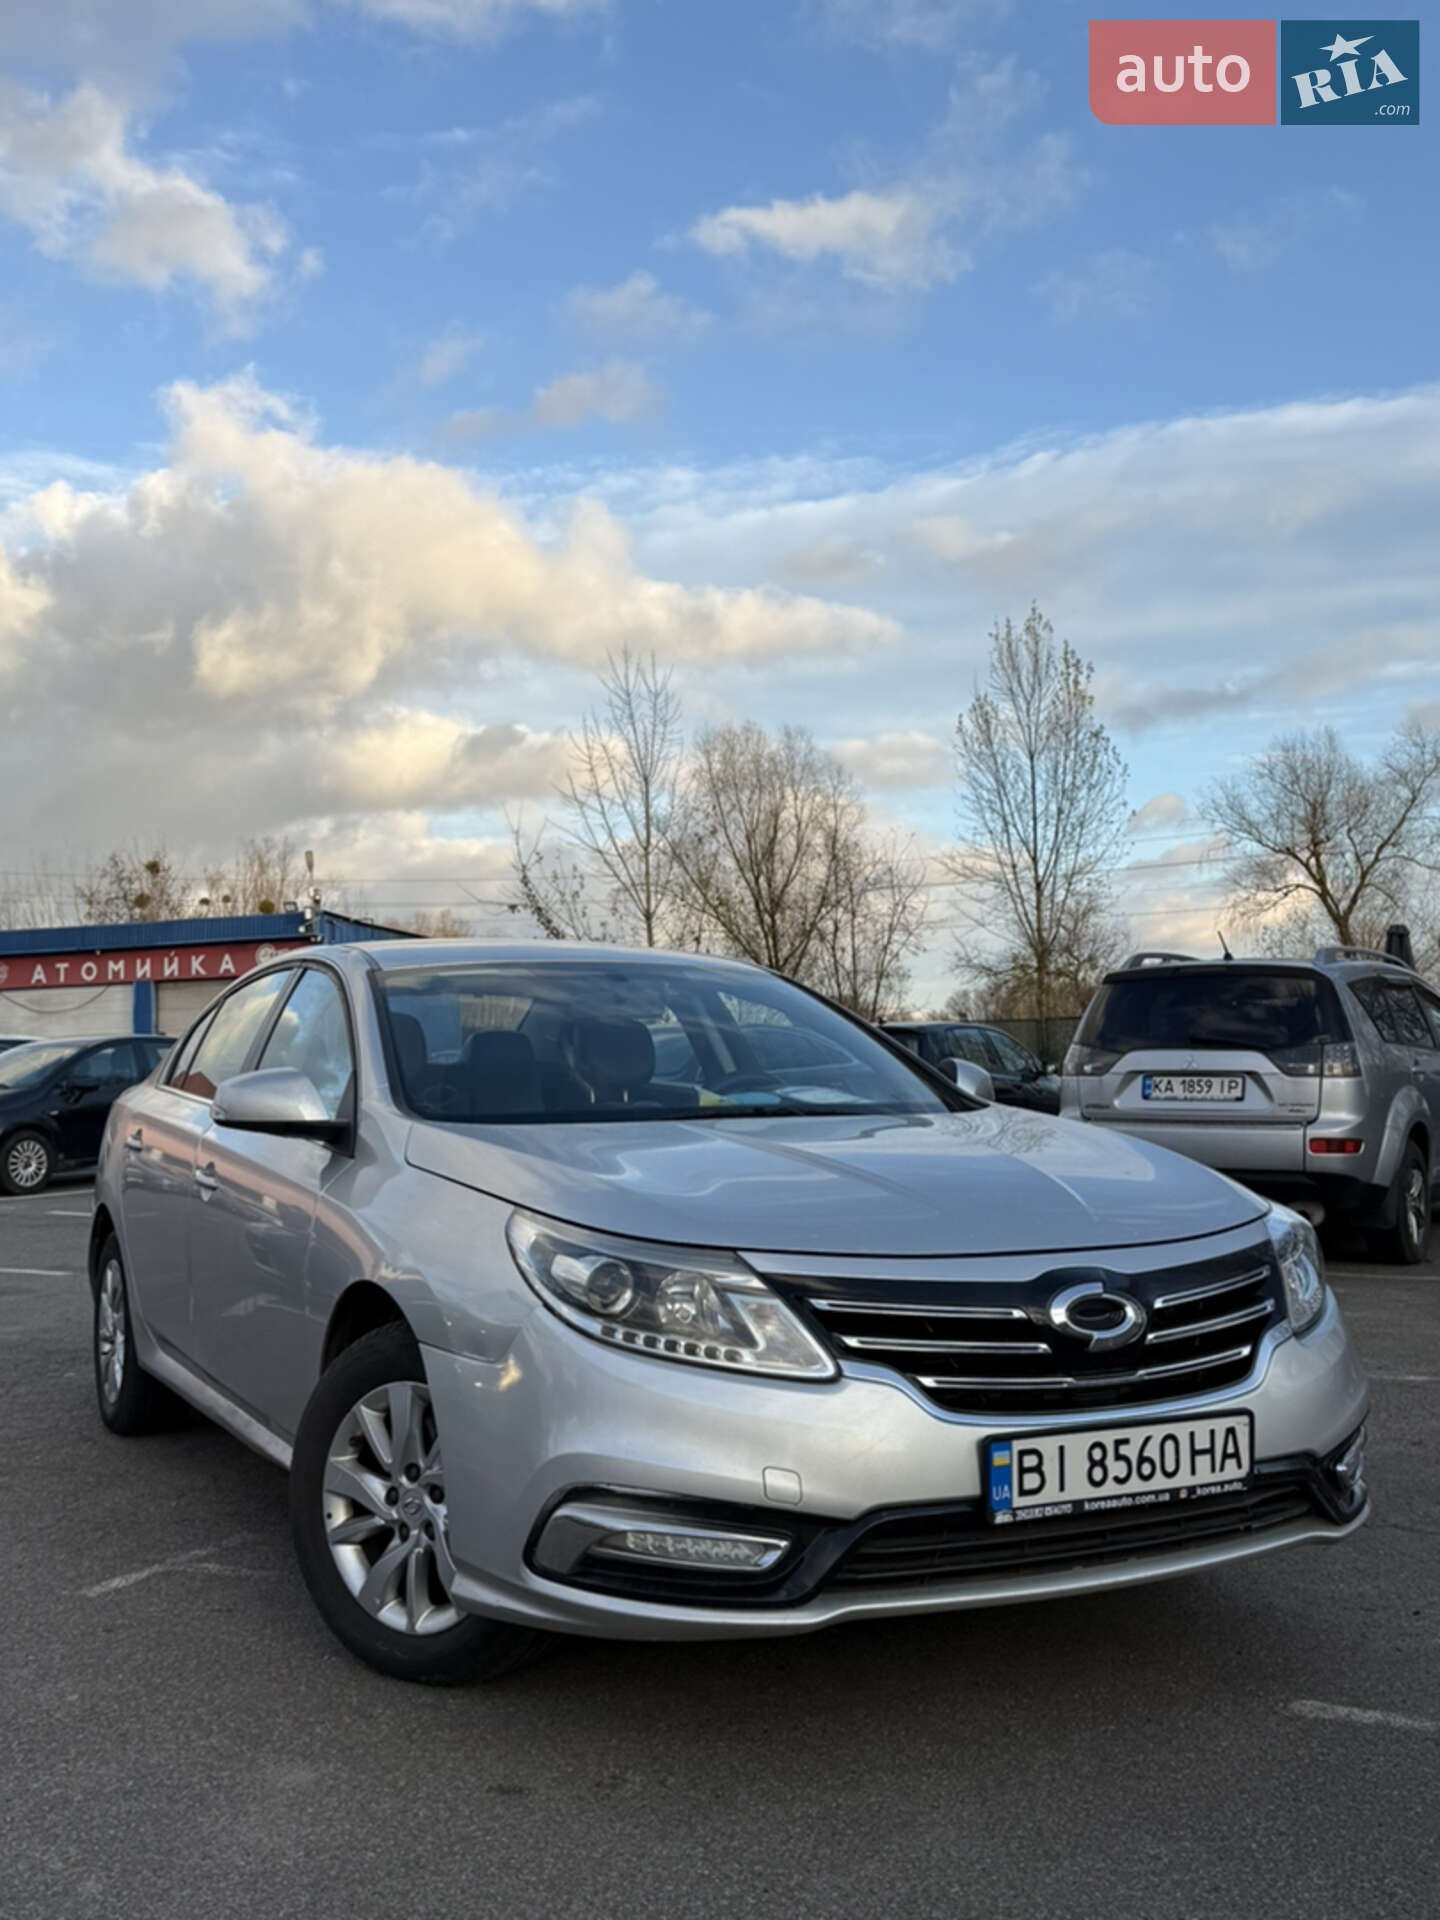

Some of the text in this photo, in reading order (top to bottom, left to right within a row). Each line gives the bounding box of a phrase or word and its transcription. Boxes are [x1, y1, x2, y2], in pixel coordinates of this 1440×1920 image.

[31, 952, 236, 985] АТОМИЙКА
[1152, 1079, 1174, 1094] KA
[1180, 1079, 1214, 1095] 1859
[1220, 1079, 1240, 1095] IP
[1017, 1426, 1243, 1498] BI 8560 HA
[992, 1484, 1011, 1501] UA
